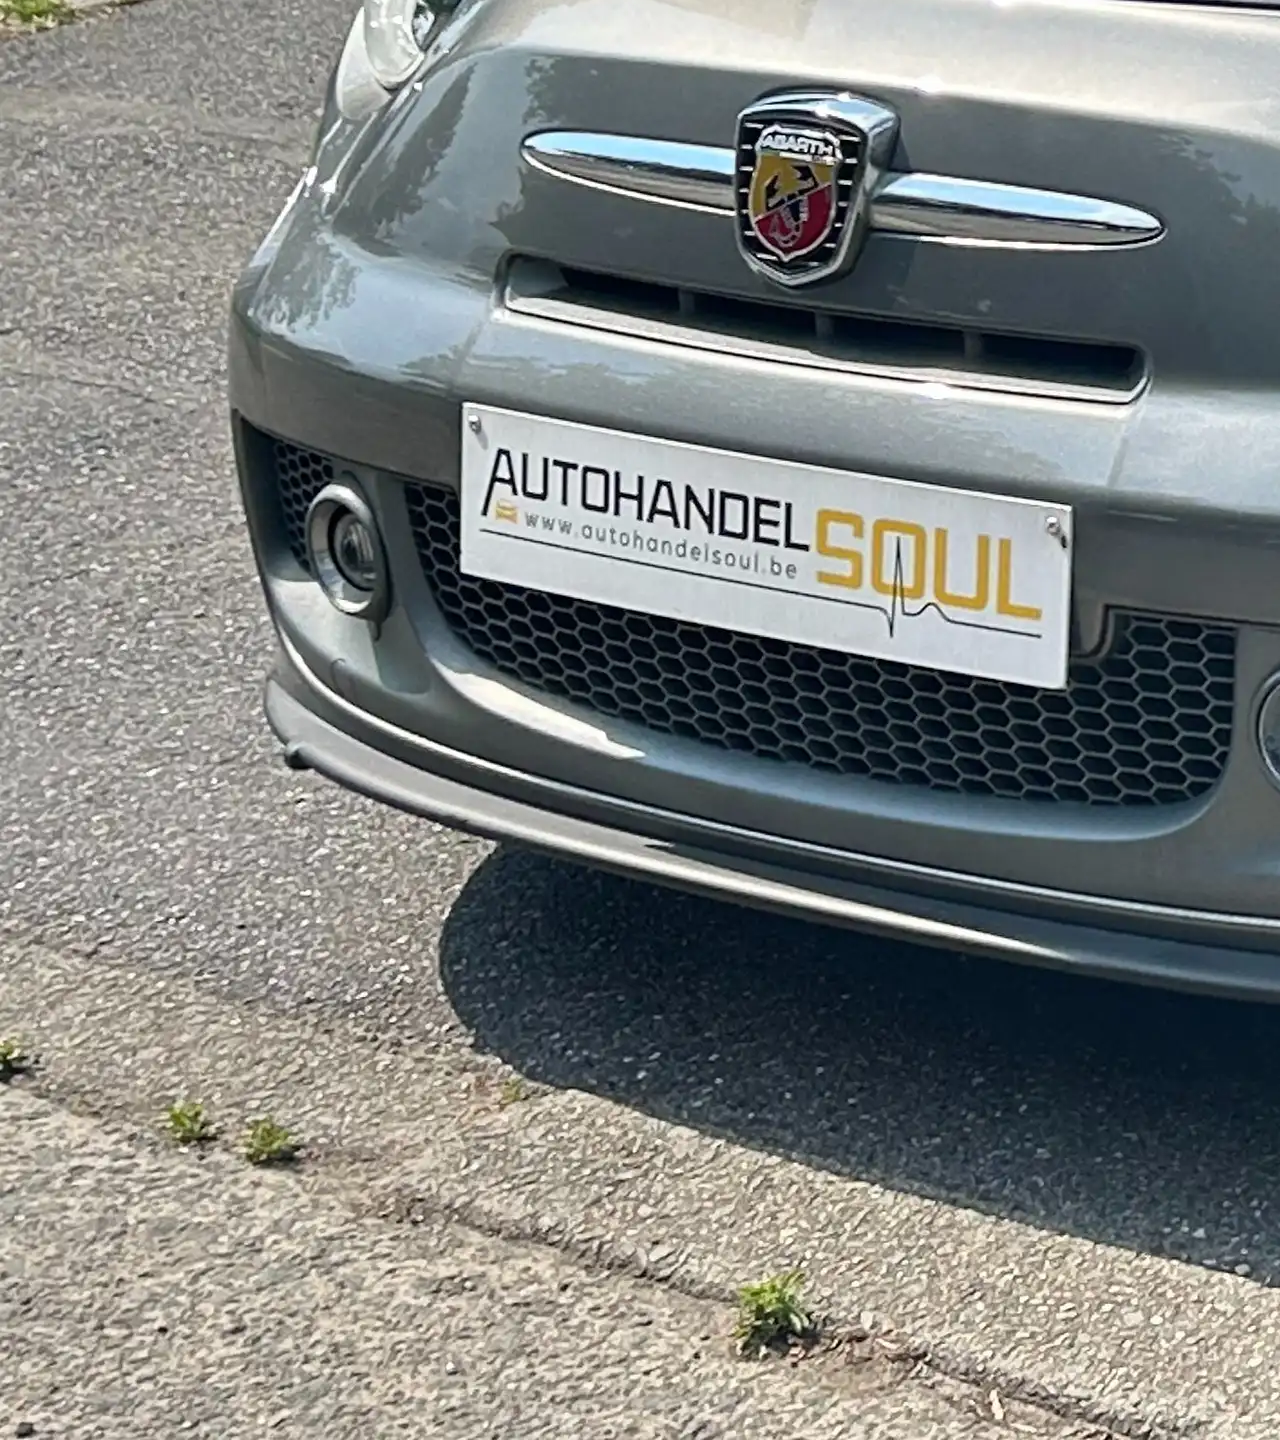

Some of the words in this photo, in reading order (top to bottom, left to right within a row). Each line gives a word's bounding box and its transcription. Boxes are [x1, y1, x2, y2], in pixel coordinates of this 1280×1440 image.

[762, 134, 834, 156] ABARTH
[481, 448, 810, 551] AUTOHANDEL
[815, 508, 1042, 621] SOUL
[525, 512, 797, 579] www.autohandelsoul.be
